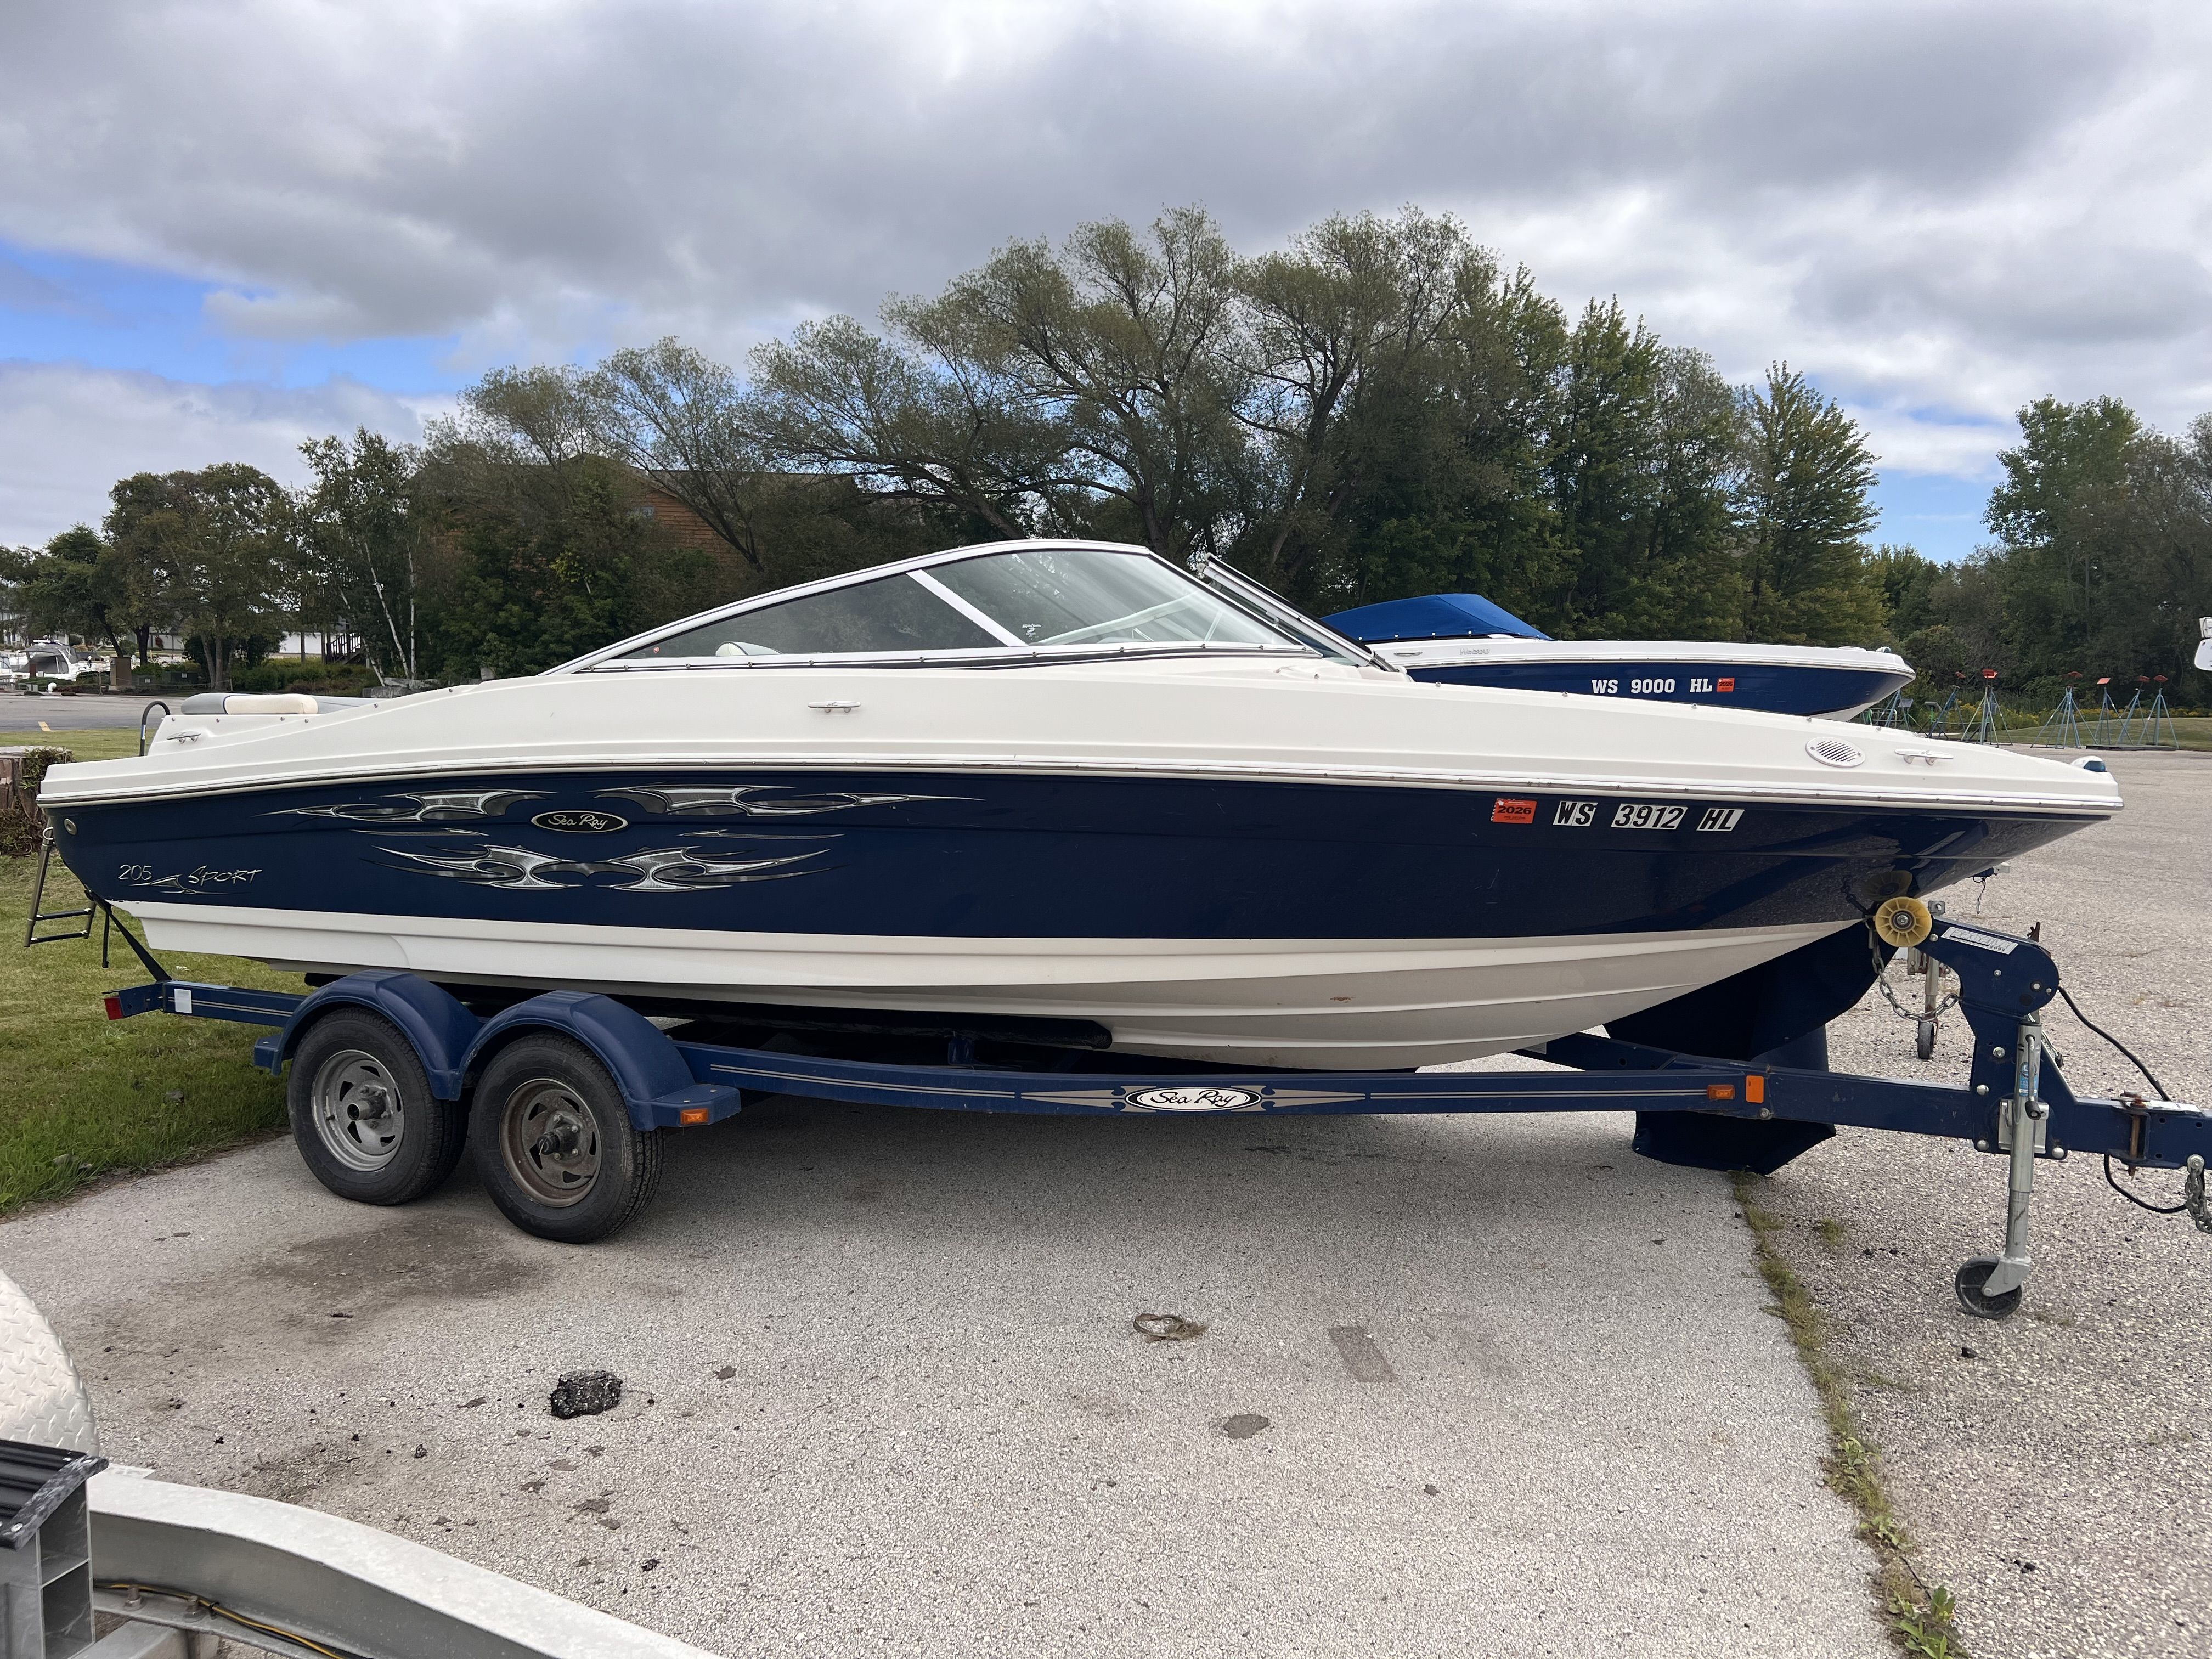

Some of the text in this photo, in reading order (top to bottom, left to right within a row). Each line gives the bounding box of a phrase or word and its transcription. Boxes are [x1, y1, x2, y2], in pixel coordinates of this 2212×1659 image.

[1592, 678, 1713, 694] WS 9000 HL
[1497, 806, 1532, 815] 2026
[1557, 802, 1736, 830] WS 3912 HL
[548, 814, 608, 830] Sea Ray
[117, 864, 153, 881] 205
[1150, 1090, 1237, 1107] Sea Ray
